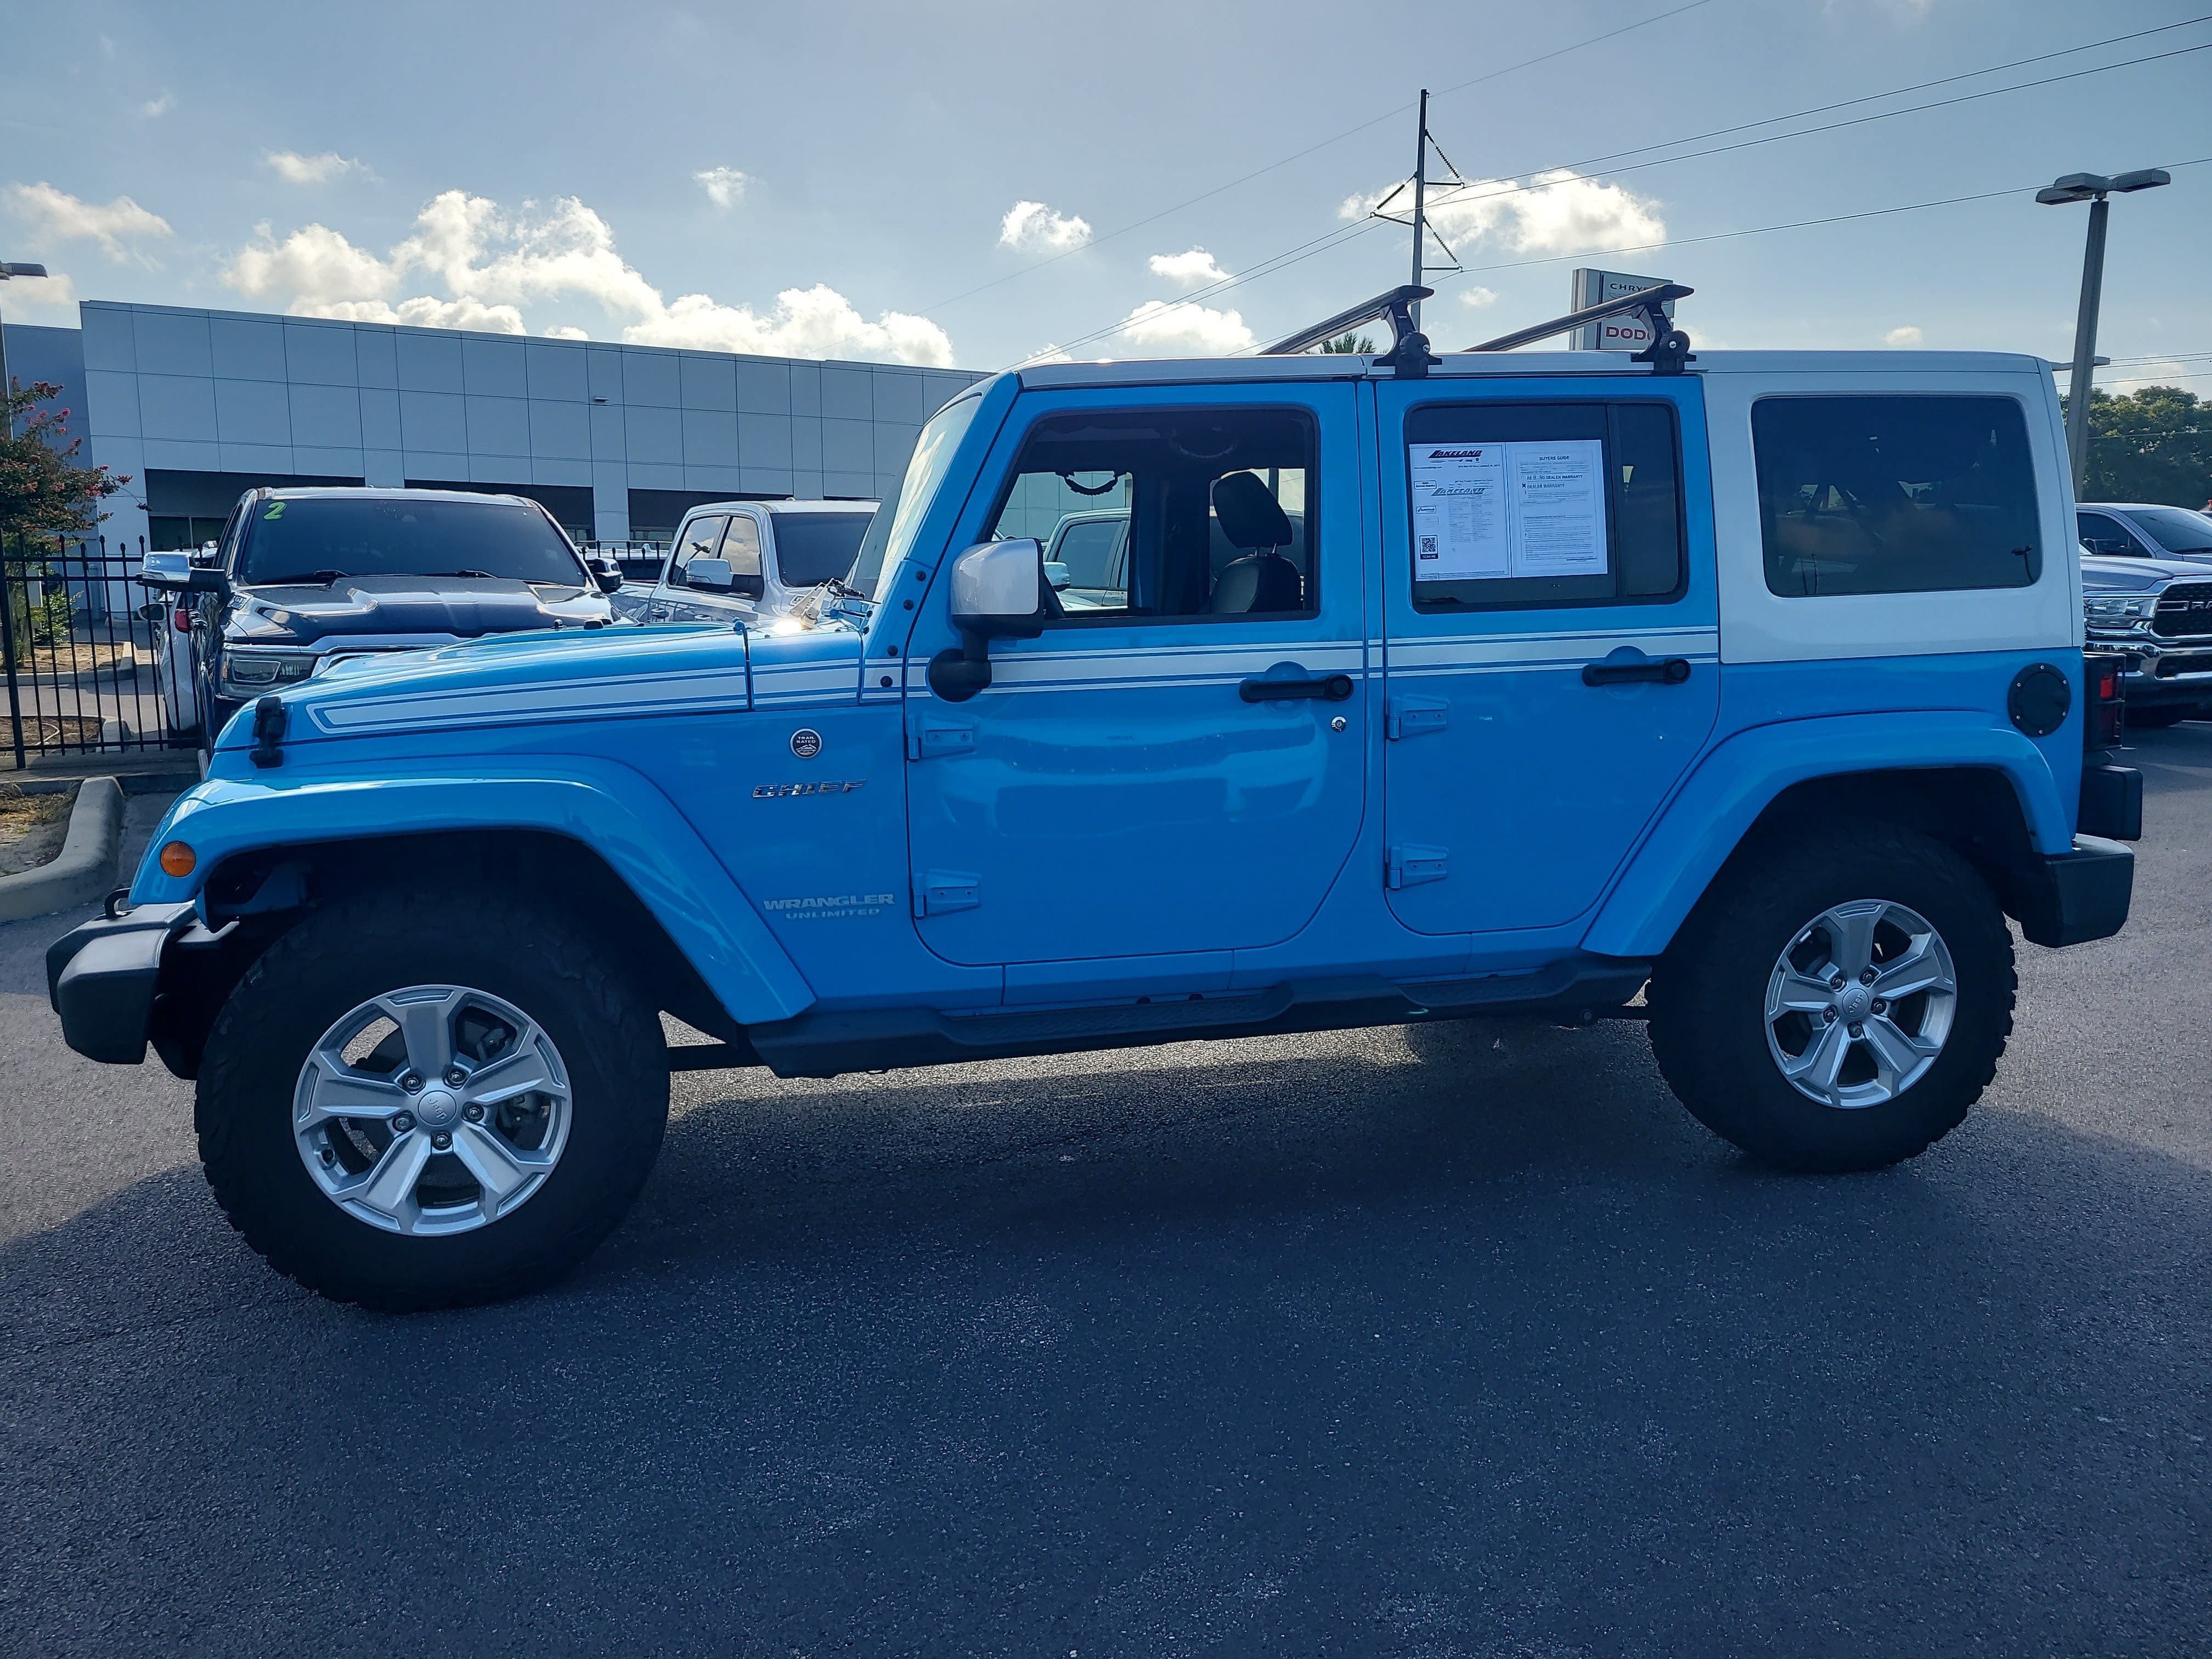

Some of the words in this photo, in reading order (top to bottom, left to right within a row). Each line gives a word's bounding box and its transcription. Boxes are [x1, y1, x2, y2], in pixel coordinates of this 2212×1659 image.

[1605, 326, 1650, 341] DOD
[1428, 450, 1483, 458] LAKELAND
[264, 501, 287, 520] 2
[752, 778, 867, 798] CHIEF
[763, 894, 896, 910] WRANGLER
[786, 908, 880, 919] UNLIMITED
[428, 1098, 447, 1120] Jeep
